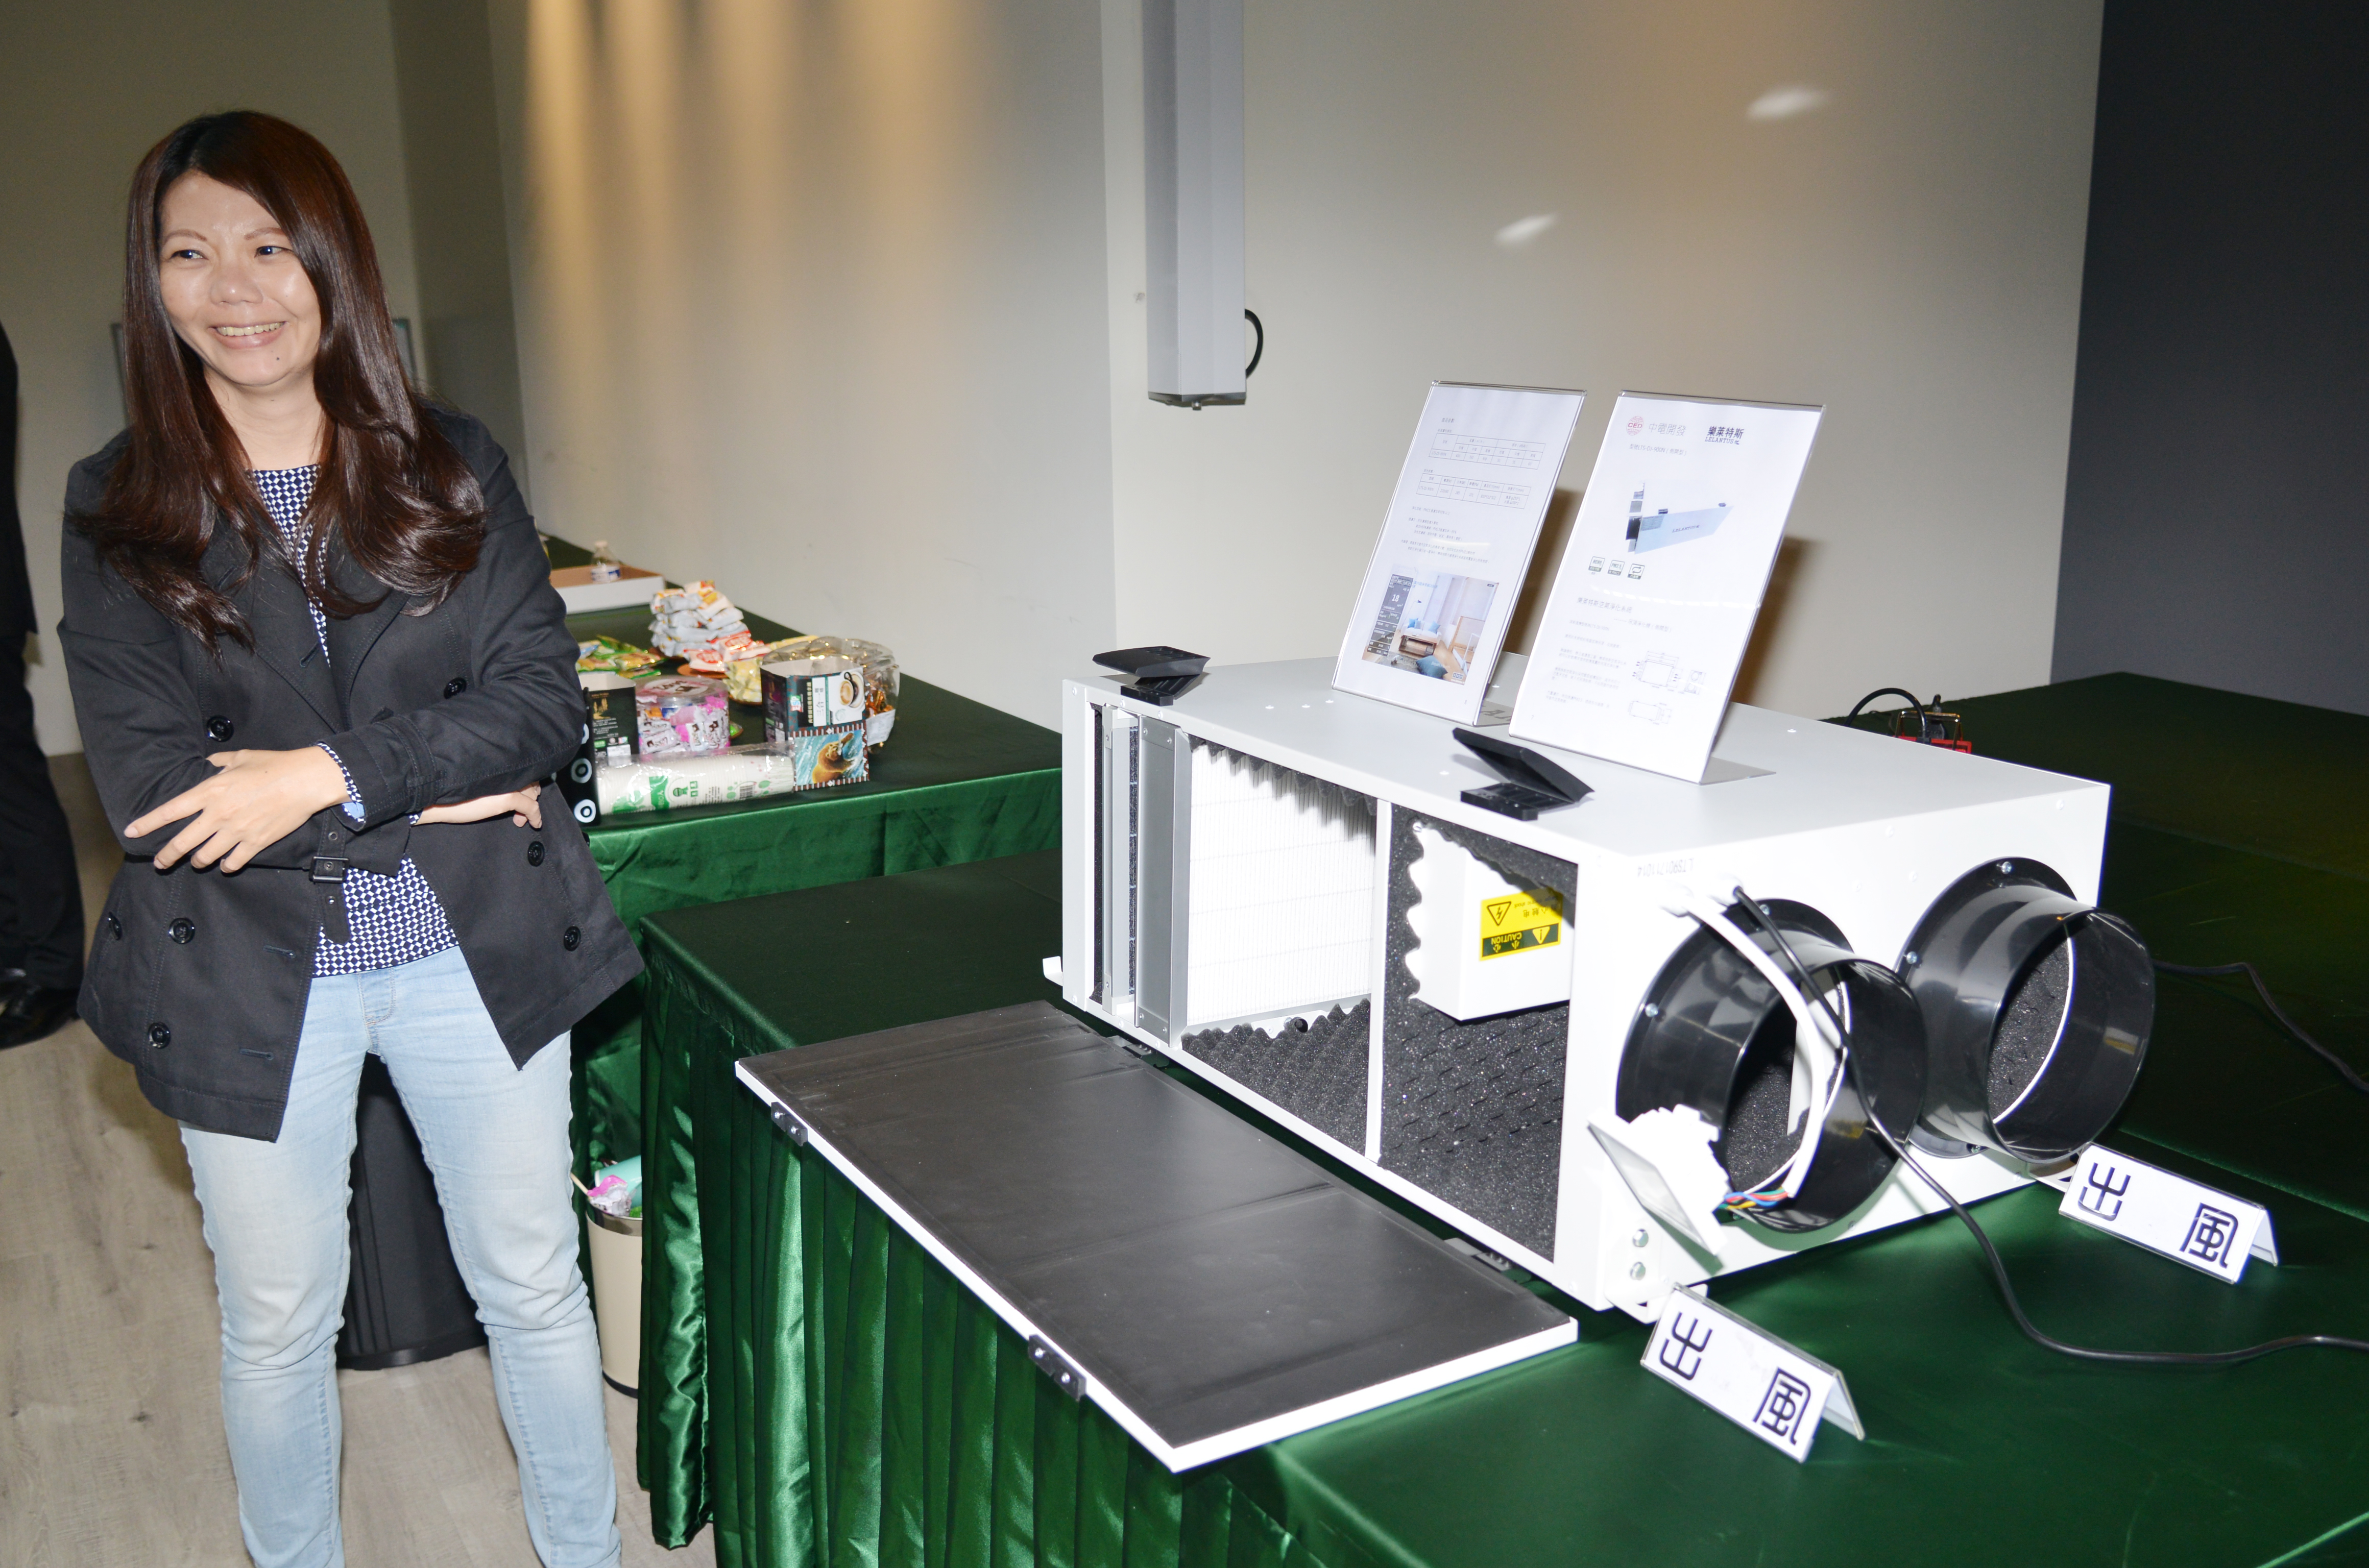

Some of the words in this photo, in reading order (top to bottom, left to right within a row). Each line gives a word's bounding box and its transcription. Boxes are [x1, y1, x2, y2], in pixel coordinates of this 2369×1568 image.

[1648, 423, 1686, 437] 中電開發
[1707, 426, 1745, 439] 樂萊特斯
[1391, 594, 1400, 602] 18
[1491, 932, 1522, 945] CAUTION
[2077, 1162, 2239, 1269] 出風
[1659, 1311, 1811, 1446] 出風
